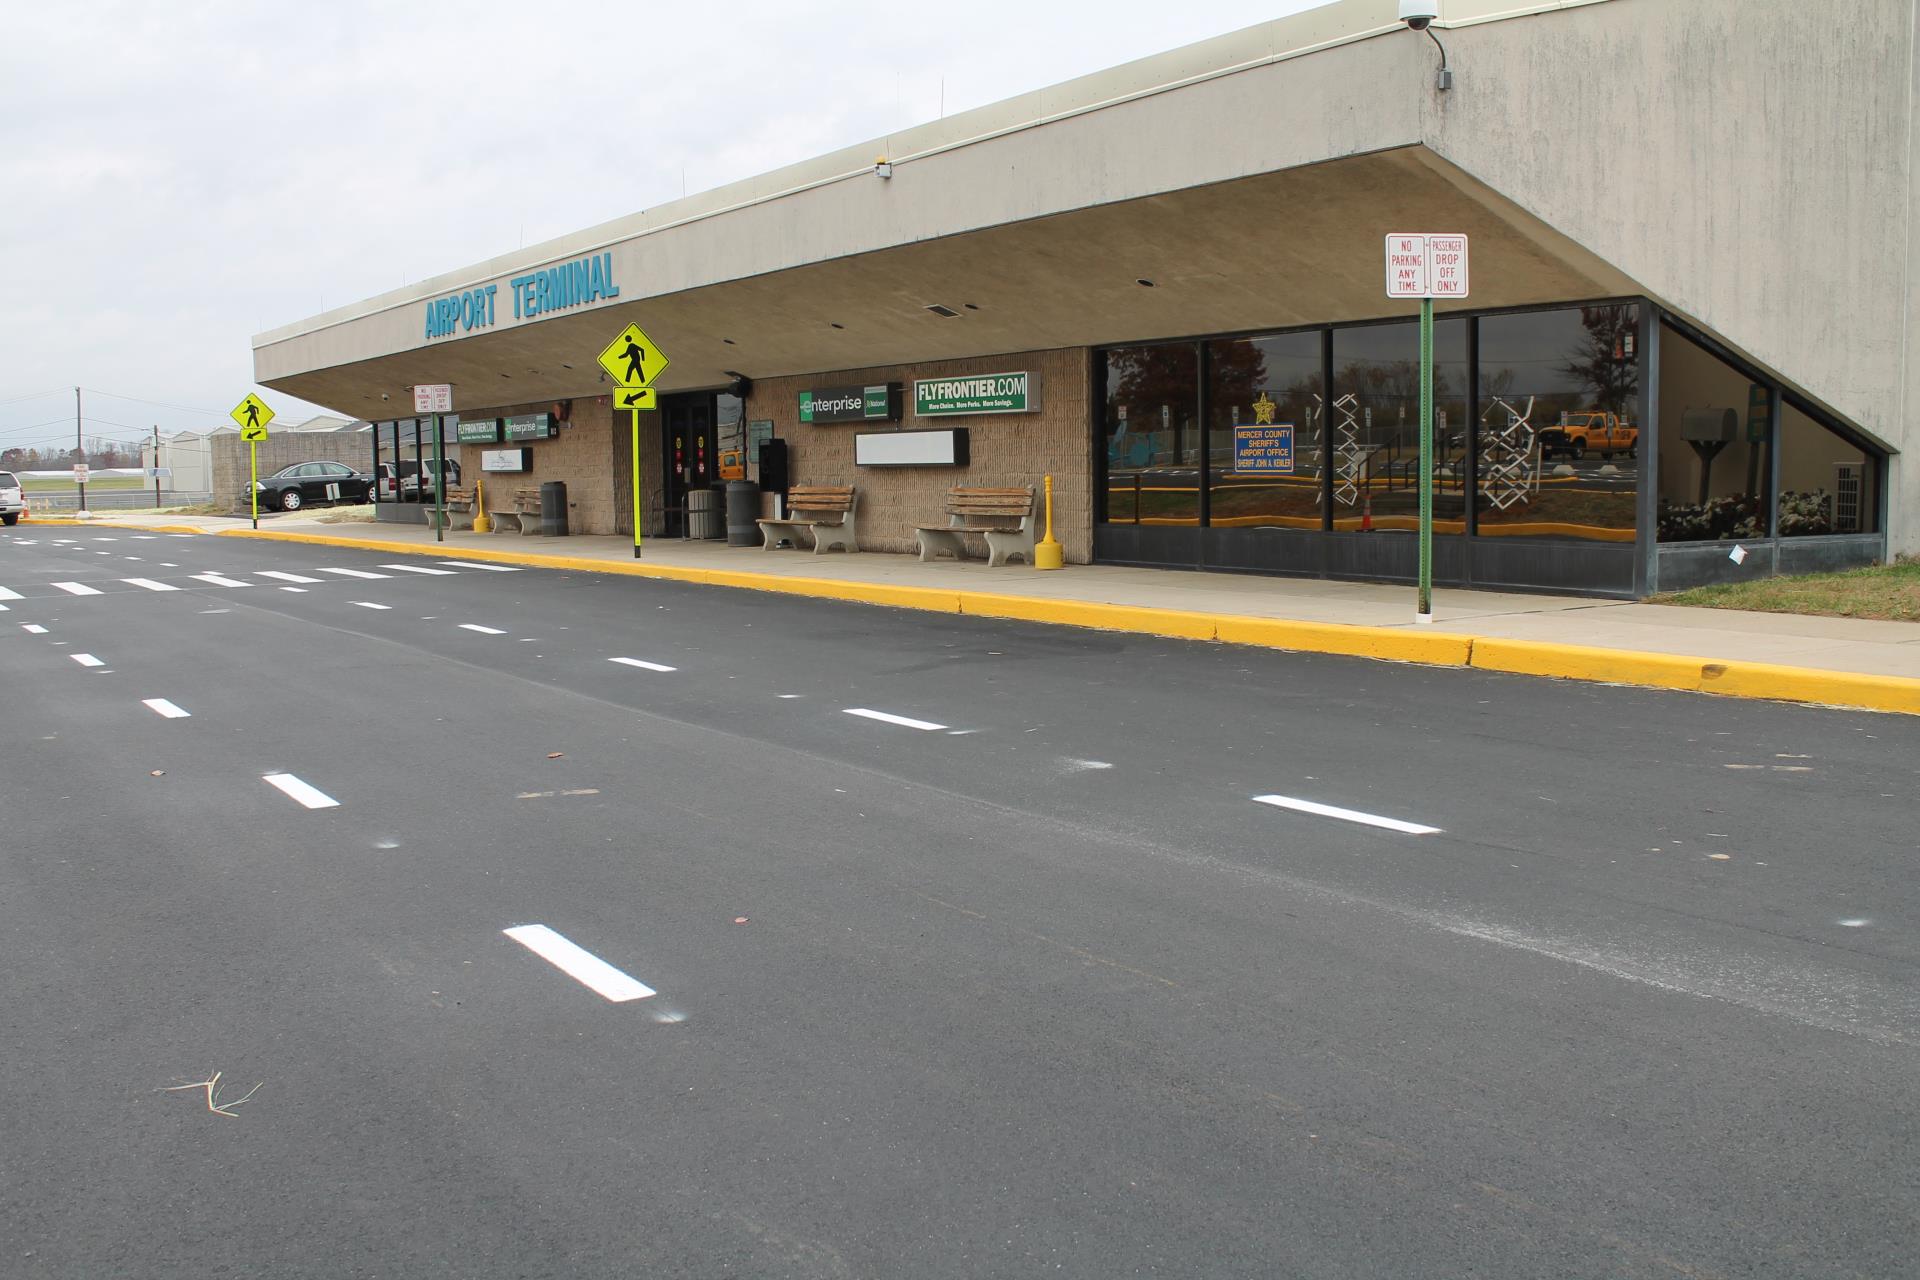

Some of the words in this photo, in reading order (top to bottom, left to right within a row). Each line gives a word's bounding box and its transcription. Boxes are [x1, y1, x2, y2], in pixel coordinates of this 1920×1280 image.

[1401, 240, 1412, 252] NO
[1432, 240, 1462, 252] PASSENGER
[1391, 255, 1422, 266] PARKING
[1436, 254, 1459, 265] DROP
[1398, 269, 1416, 279] ANY
[1440, 267, 1456, 278] OFF
[1398, 281, 1417, 291] TIME
[1437, 280, 1458, 292] ONLY
[425, 284, 497, 339] AIRPORT
[510, 252, 620, 320] TERMINAL
[918, 377, 1025, 401] FLYFRONTIER.COM
[800, 394, 862, 415] enterprise
[1238, 430, 1262, 438] MERCER
[1264, 430, 1290, 438] COUNTY
[1248, 439, 1279, 447] SHERIFF'S
[1266, 448, 1289, 456] OFFICE
[1237, 459, 1254, 468] SHERIFF
[1255, 459, 1267, 468] JOHN
